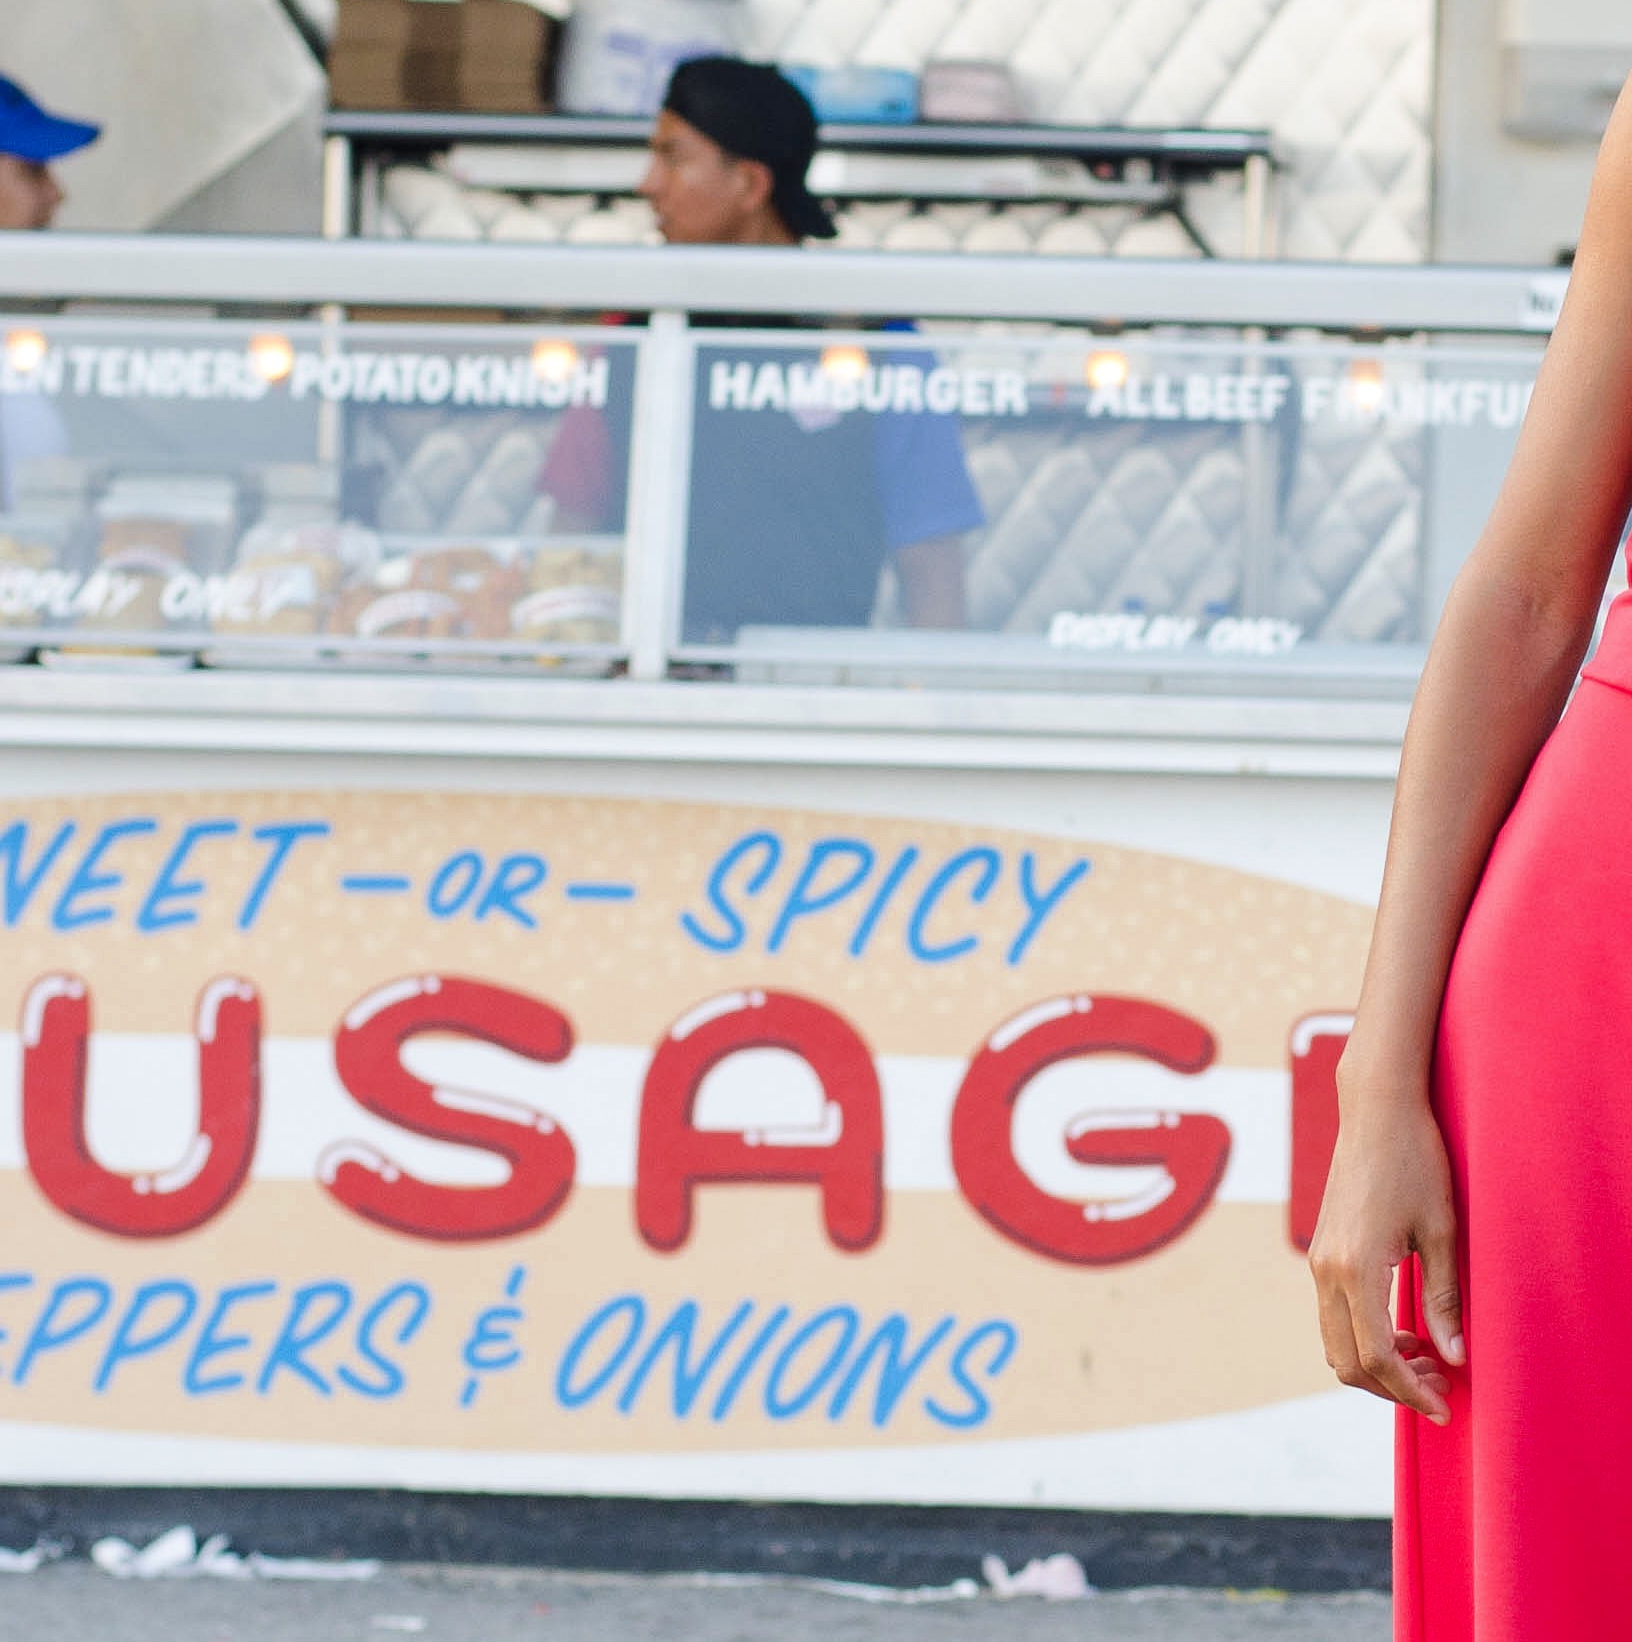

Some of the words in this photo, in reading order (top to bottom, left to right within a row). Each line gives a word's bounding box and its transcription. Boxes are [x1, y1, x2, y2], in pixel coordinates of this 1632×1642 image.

[290, 353, 452, 403] POTATO
[1184, 375, 1291, 423] BEEF
[678, 829, 1092, 967] SPICY
[554, 1294, 1018, 1430] ONIONS
